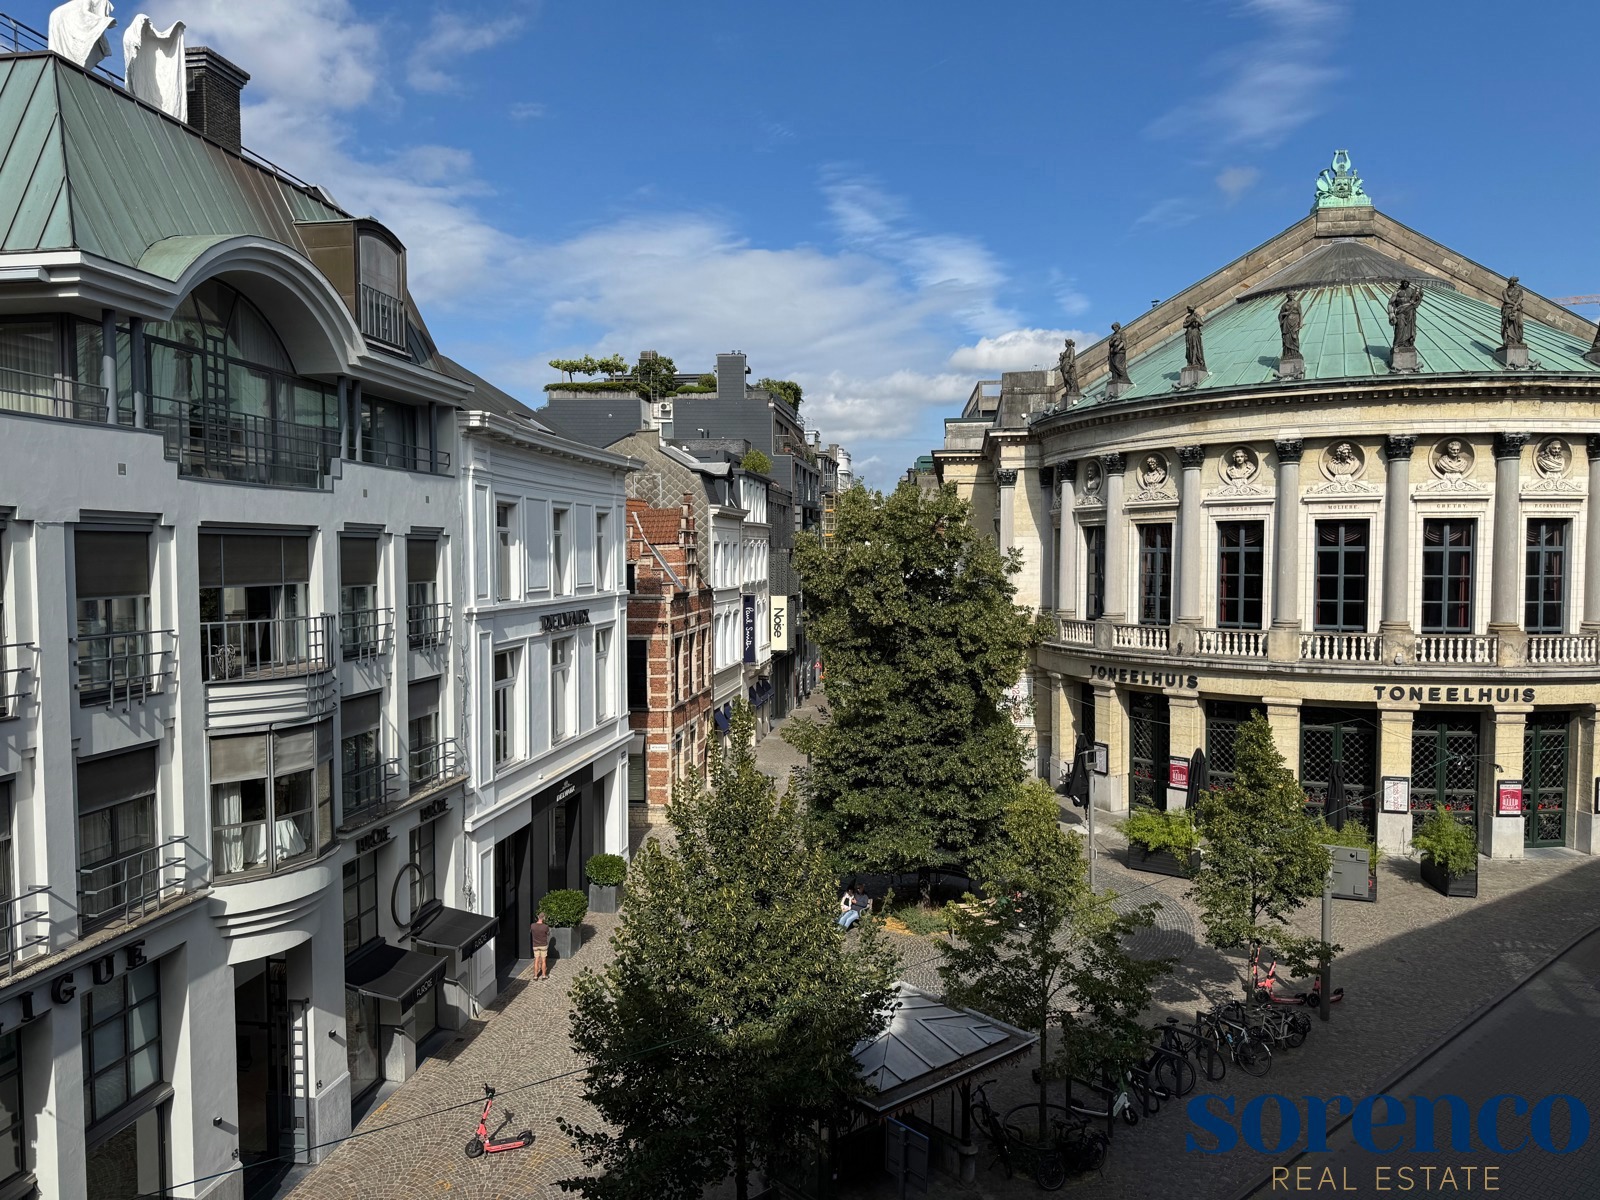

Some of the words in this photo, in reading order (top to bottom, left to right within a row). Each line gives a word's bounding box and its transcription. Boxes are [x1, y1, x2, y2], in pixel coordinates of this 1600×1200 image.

[540, 609, 590, 630] DELVAUX
[745, 607, 754, 625] Paul
[774, 608, 784, 638] Noise
[745, 626, 753, 651] Smith
[1090, 665, 1198, 689] TONEELHUIS
[1374, 686, 1535, 703] TONEELHUIS
